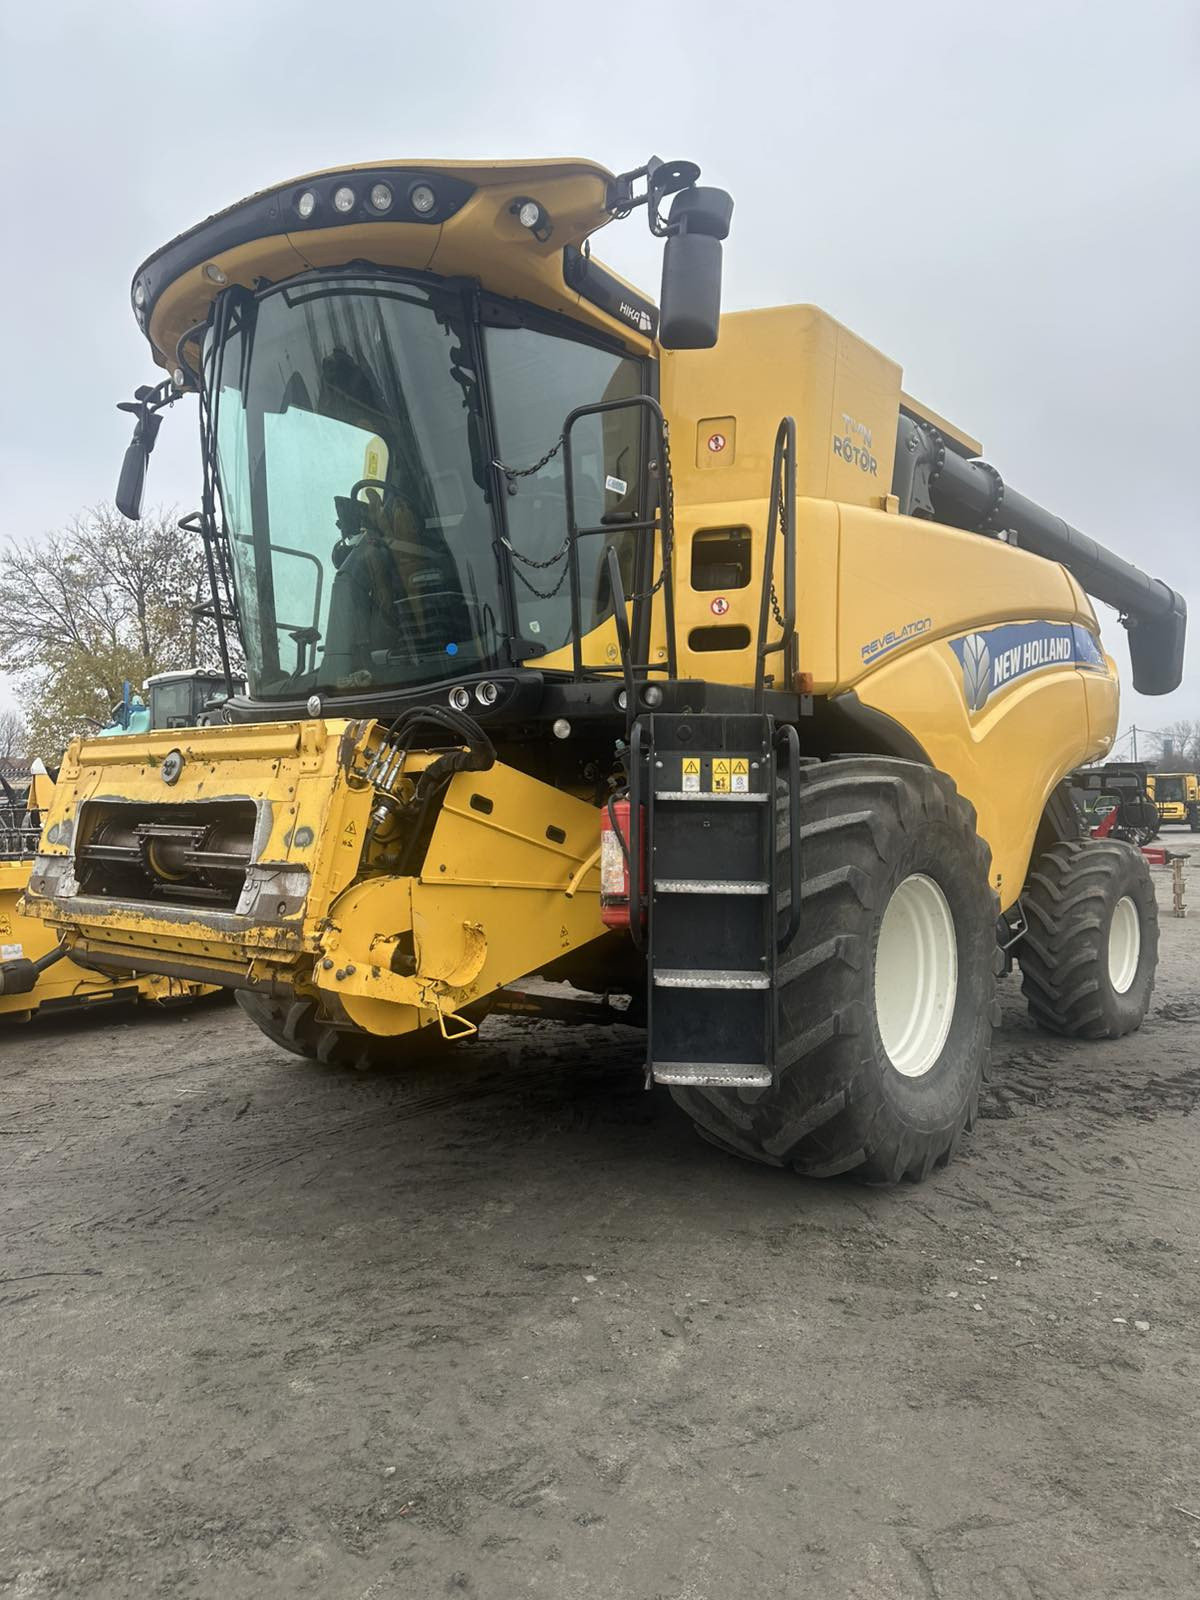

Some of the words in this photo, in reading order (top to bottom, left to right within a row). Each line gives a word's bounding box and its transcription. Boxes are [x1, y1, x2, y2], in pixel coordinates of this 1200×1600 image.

[833, 434, 878, 478] ROTOR
[861, 617, 932, 659] REVELATION
[993, 645, 1022, 687] NEW
[1022, 637, 1072, 670] HOLLAND
